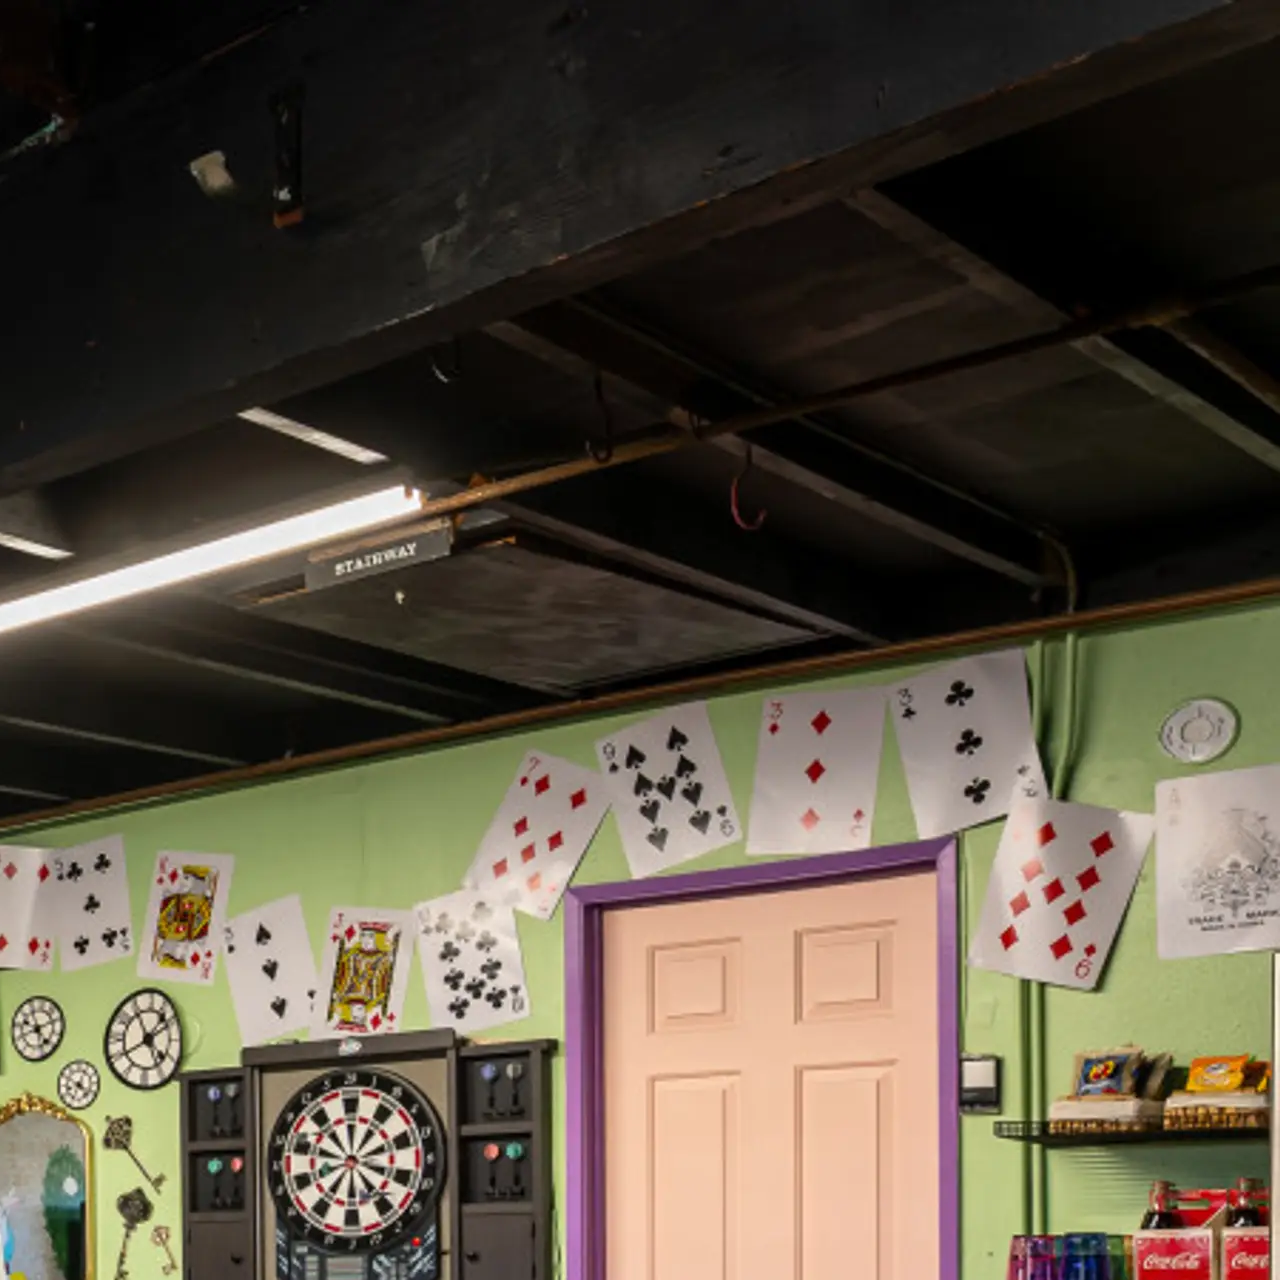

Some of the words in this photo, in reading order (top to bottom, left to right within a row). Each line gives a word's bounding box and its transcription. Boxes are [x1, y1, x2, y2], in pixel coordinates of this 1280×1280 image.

[334, 542, 416, 576] STAIRWAY
[899, 688, 914, 706] 3
[768, 702, 783, 720] 3
[602, 742, 617, 760] 9
